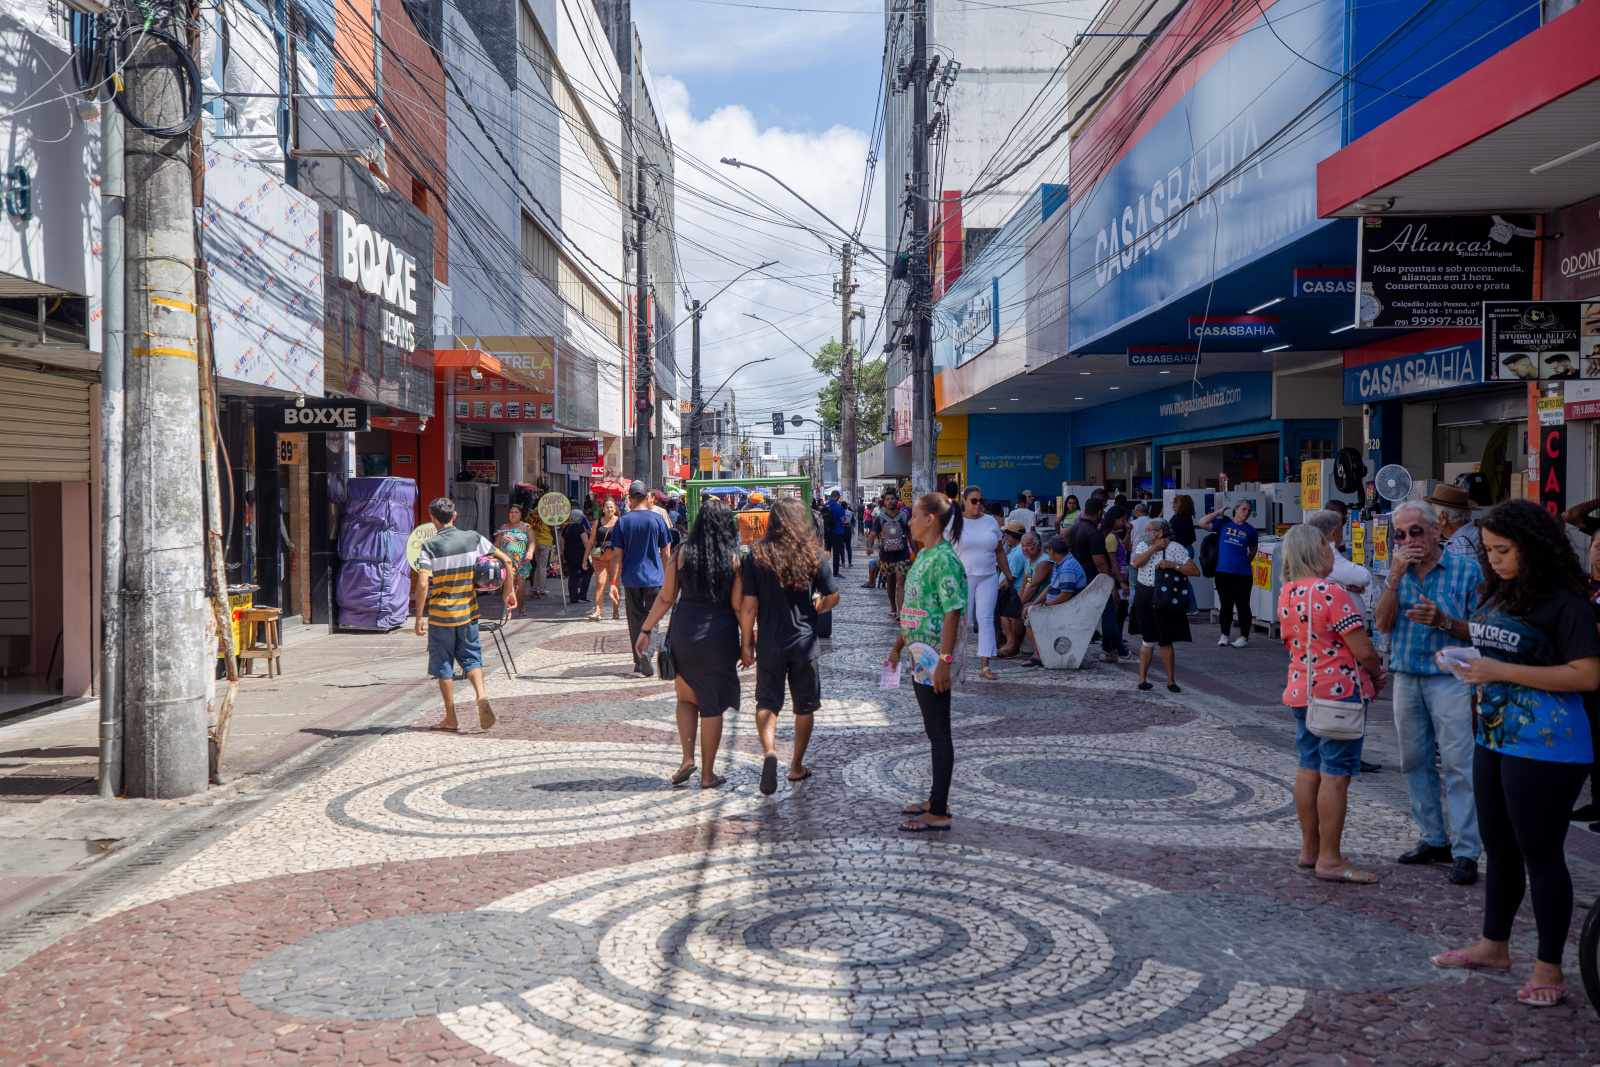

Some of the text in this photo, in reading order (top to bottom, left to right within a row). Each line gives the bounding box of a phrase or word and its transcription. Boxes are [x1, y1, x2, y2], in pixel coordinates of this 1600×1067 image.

[1095, 108, 1263, 288] CASASBAHIA
[1368, 223, 1491, 255] Alianças
[338, 210, 417, 315] BOXXE
[1373, 265, 1396, 273] Jóias
[1398, 266, 1436, 274] prontas
[1464, 265, 1524, 273] encomenda,
[1401, 273, 1441, 282] alianças
[1385, 282, 1449, 290] Consertamos
[1483, 282, 1510, 291] prata
[381, 309, 415, 353] JEANS
[1194, 326, 1275, 336] CASASBAHIA
[1546, 332, 1577, 340] BELEZA
[496, 355, 552, 370] STRELA
[1132, 355, 1197, 363] CASASBAHIA
[1359, 349, 1474, 397] CASASBAHIA
[1160, 387, 1241, 417] www.magazineluiza.com
[284, 407, 356, 424] BOXXE
[280, 440, 293, 461] 89
[1368, 438, 1380, 450] 320
[980, 459, 996, 468] até
[998, 460, 1015, 468] 24x
[542, 494, 564, 505] COMPRO
[540, 502, 570, 517] OURO
[415, 527, 437, 539] COMP
[1225, 527, 1237, 537] 11
[1485, 625, 1521, 647] CRED
[924, 636, 941, 654] HOR
